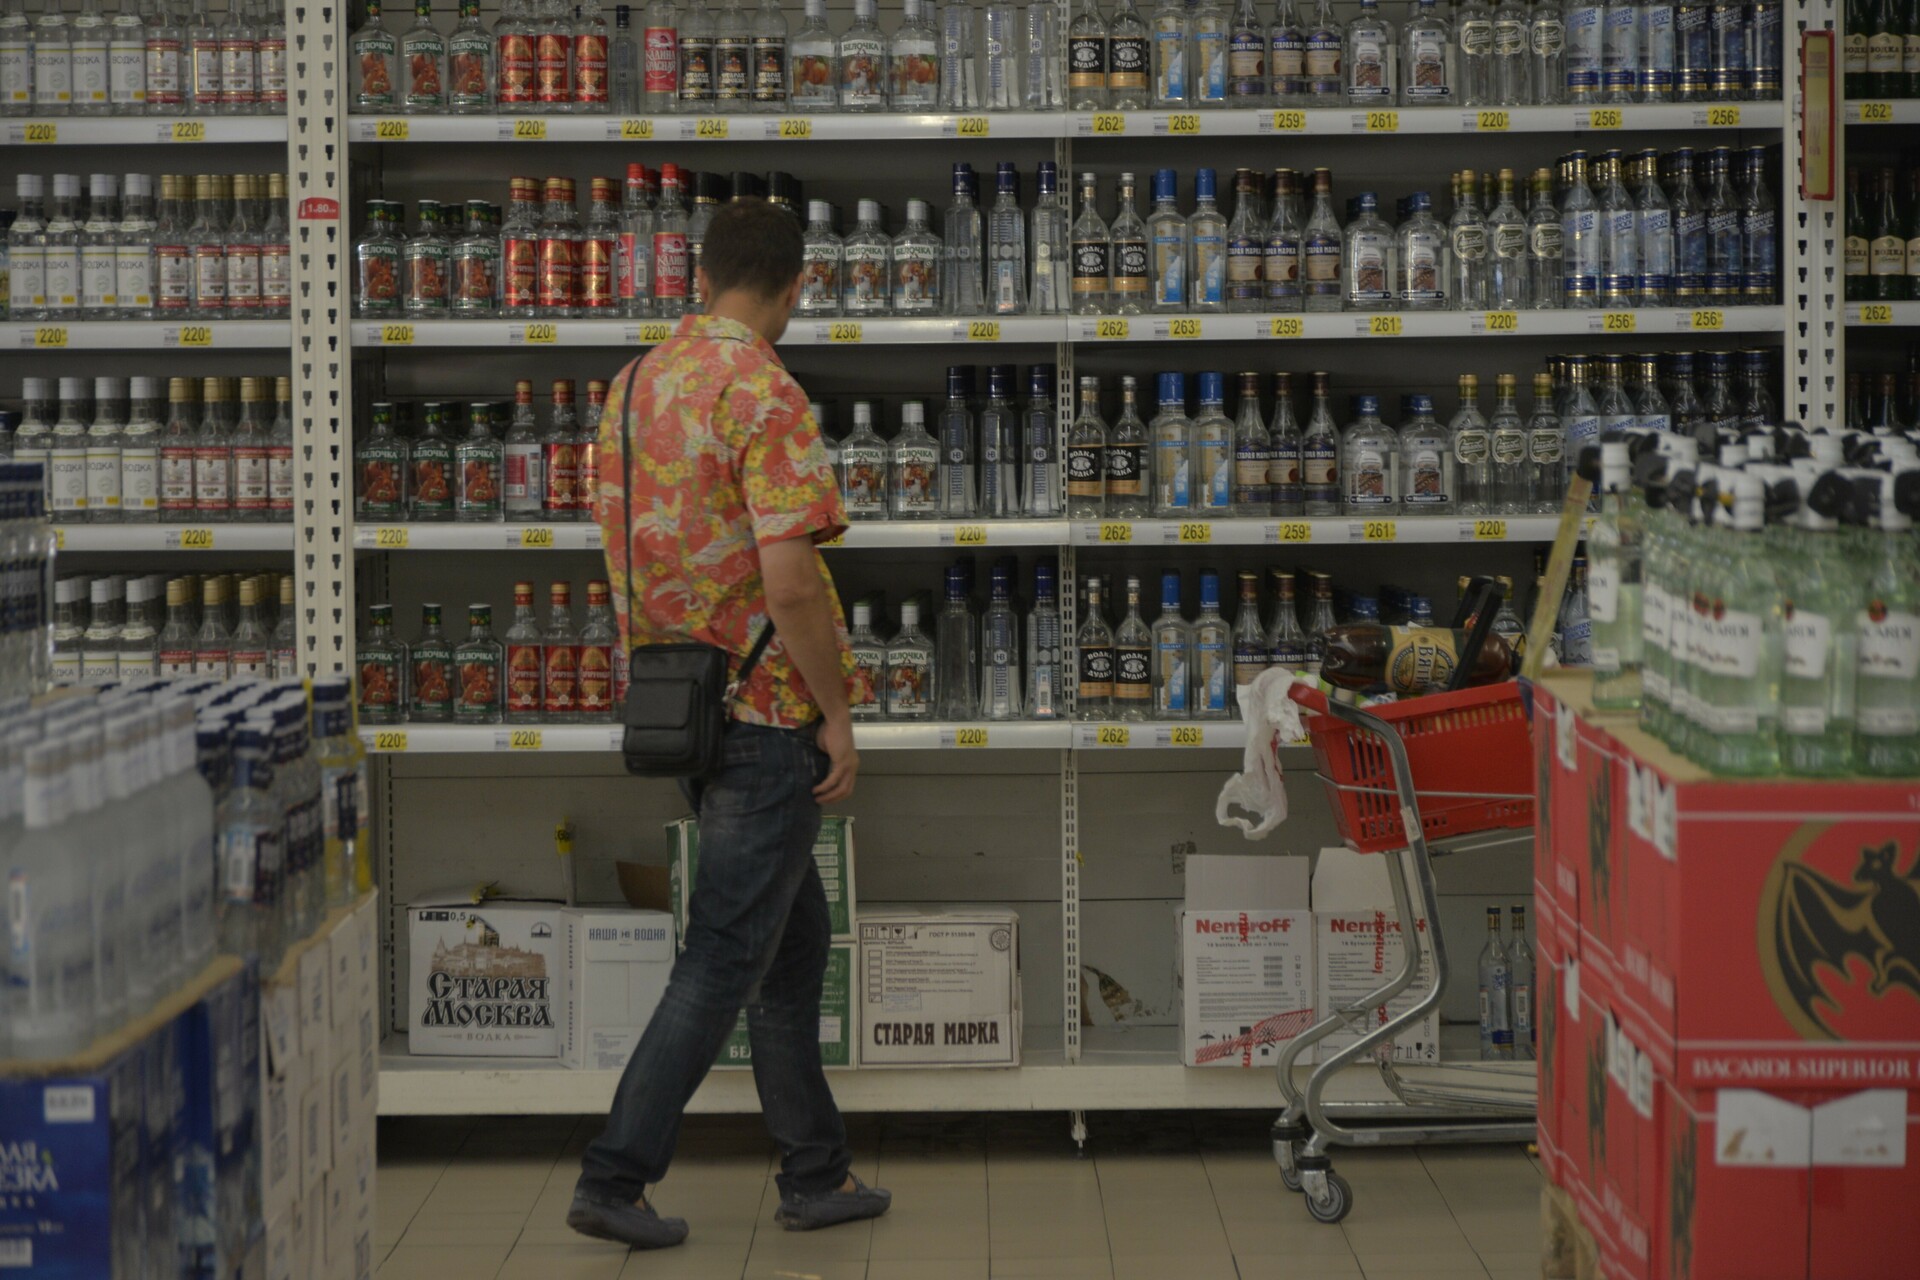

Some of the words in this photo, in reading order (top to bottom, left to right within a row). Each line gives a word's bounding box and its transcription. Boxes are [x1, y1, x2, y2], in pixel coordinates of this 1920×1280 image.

[355, 42, 393, 52] БЕЛОЧКА
[405, 41, 442, 52] БЕЛОЧКА
[451, 41, 488, 51] БЕЛОЧКА
[844, 42, 879, 52] БЕЛОЧКА
[1713, 110, 1734, 125] 256
[1865, 104, 1886, 118] 262
[962, 118, 983, 133] 220
[1097, 116, 1119, 131] 262
[1173, 115, 1194, 130] 263
[1278, 113, 1300, 128] 259
[1371, 113, 1392, 128] 261
[1482, 112, 1503, 127] 220
[1594, 111, 1616, 126] 256
[29, 125, 50, 140] 220
[177, 122, 198, 137] 220
[381, 121, 402, 136] 220
[518, 120, 539, 135] 220
[626, 120, 647, 135] 220
[700, 120, 722, 135] 234
[785, 120, 806, 135] 230
[362, 246, 397, 255] БЕЛОЧКА
[406, 246, 442, 255] БЕЛОЧКА
[454, 246, 490, 255] БЕЛОЧКА
[804, 247, 836, 256] ЕЛОЧКА
[847, 246, 883, 256] БЕЛОЧКА
[895, 246, 932, 256] БЕЛОЧКА
[1696, 311, 1717, 326] 256
[1865, 306, 1886, 320] 262
[1174, 320, 1195, 334] 263
[1276, 320, 1297, 334] 259
[1375, 317, 1395, 332] 261
[1490, 314, 1511, 329] 220
[1608, 314, 1629, 328] 256
[183, 327, 205, 341] 220
[387, 327, 408, 341] 220
[529, 324, 550, 338] 220
[645, 326, 666, 340] 220
[835, 324, 856, 338] 230
[972, 322, 993, 337] 220
[1102, 321, 1123, 336] 262
[40, 329, 61, 343] 220
[361, 449, 398, 459] БЕЛОЧКА
[413, 449, 449, 459] БЕЛОЧКА
[458, 449, 495, 459] БЕЛОЧКА
[844, 450, 880, 460] БЕЛОЧКА
[897, 450, 933, 460] БЕЛОЧКА
[960, 527, 980, 541] 220
[1105, 526, 1126, 540] 262
[1183, 525, 1204, 539] 263
[1284, 525, 1305, 539] 259
[1369, 523, 1389, 537] 261
[1479, 521, 1500, 535] 220
[185, 530, 206, 544] 220
[381, 530, 402, 544] 220
[526, 529, 546, 543] 220
[357, 651, 393, 661] БЕЛОЧКА
[414, 650, 450, 660] БЕЛОЧКА
[457, 651, 494, 661] БЕЛОЧКА
[890, 651, 925, 661] БЕЛОЧКА
[380, 733, 400, 748] 220
[514, 731, 535, 745] 220
[960, 729, 981, 743] 220
[1102, 729, 1123, 743] 262
[1176, 728, 1196, 742] 263
[451, 912, 466, 921] 0,5
[589, 929, 617, 940] НАША
[634, 929, 666, 940] ВОДКА
[428, 972, 547, 1000] СТАРАЯ
[423, 1000, 553, 1027] МОСКВА
[467, 1033, 511, 1041] ВОДКА
[874, 1023, 935, 1045] СТАРАЯ
[945, 1022, 999, 1044] МАРКА
[1693, 1056, 1790, 1079] BACARDI
[1797, 1056, 1911, 1079] SUPERIOR
